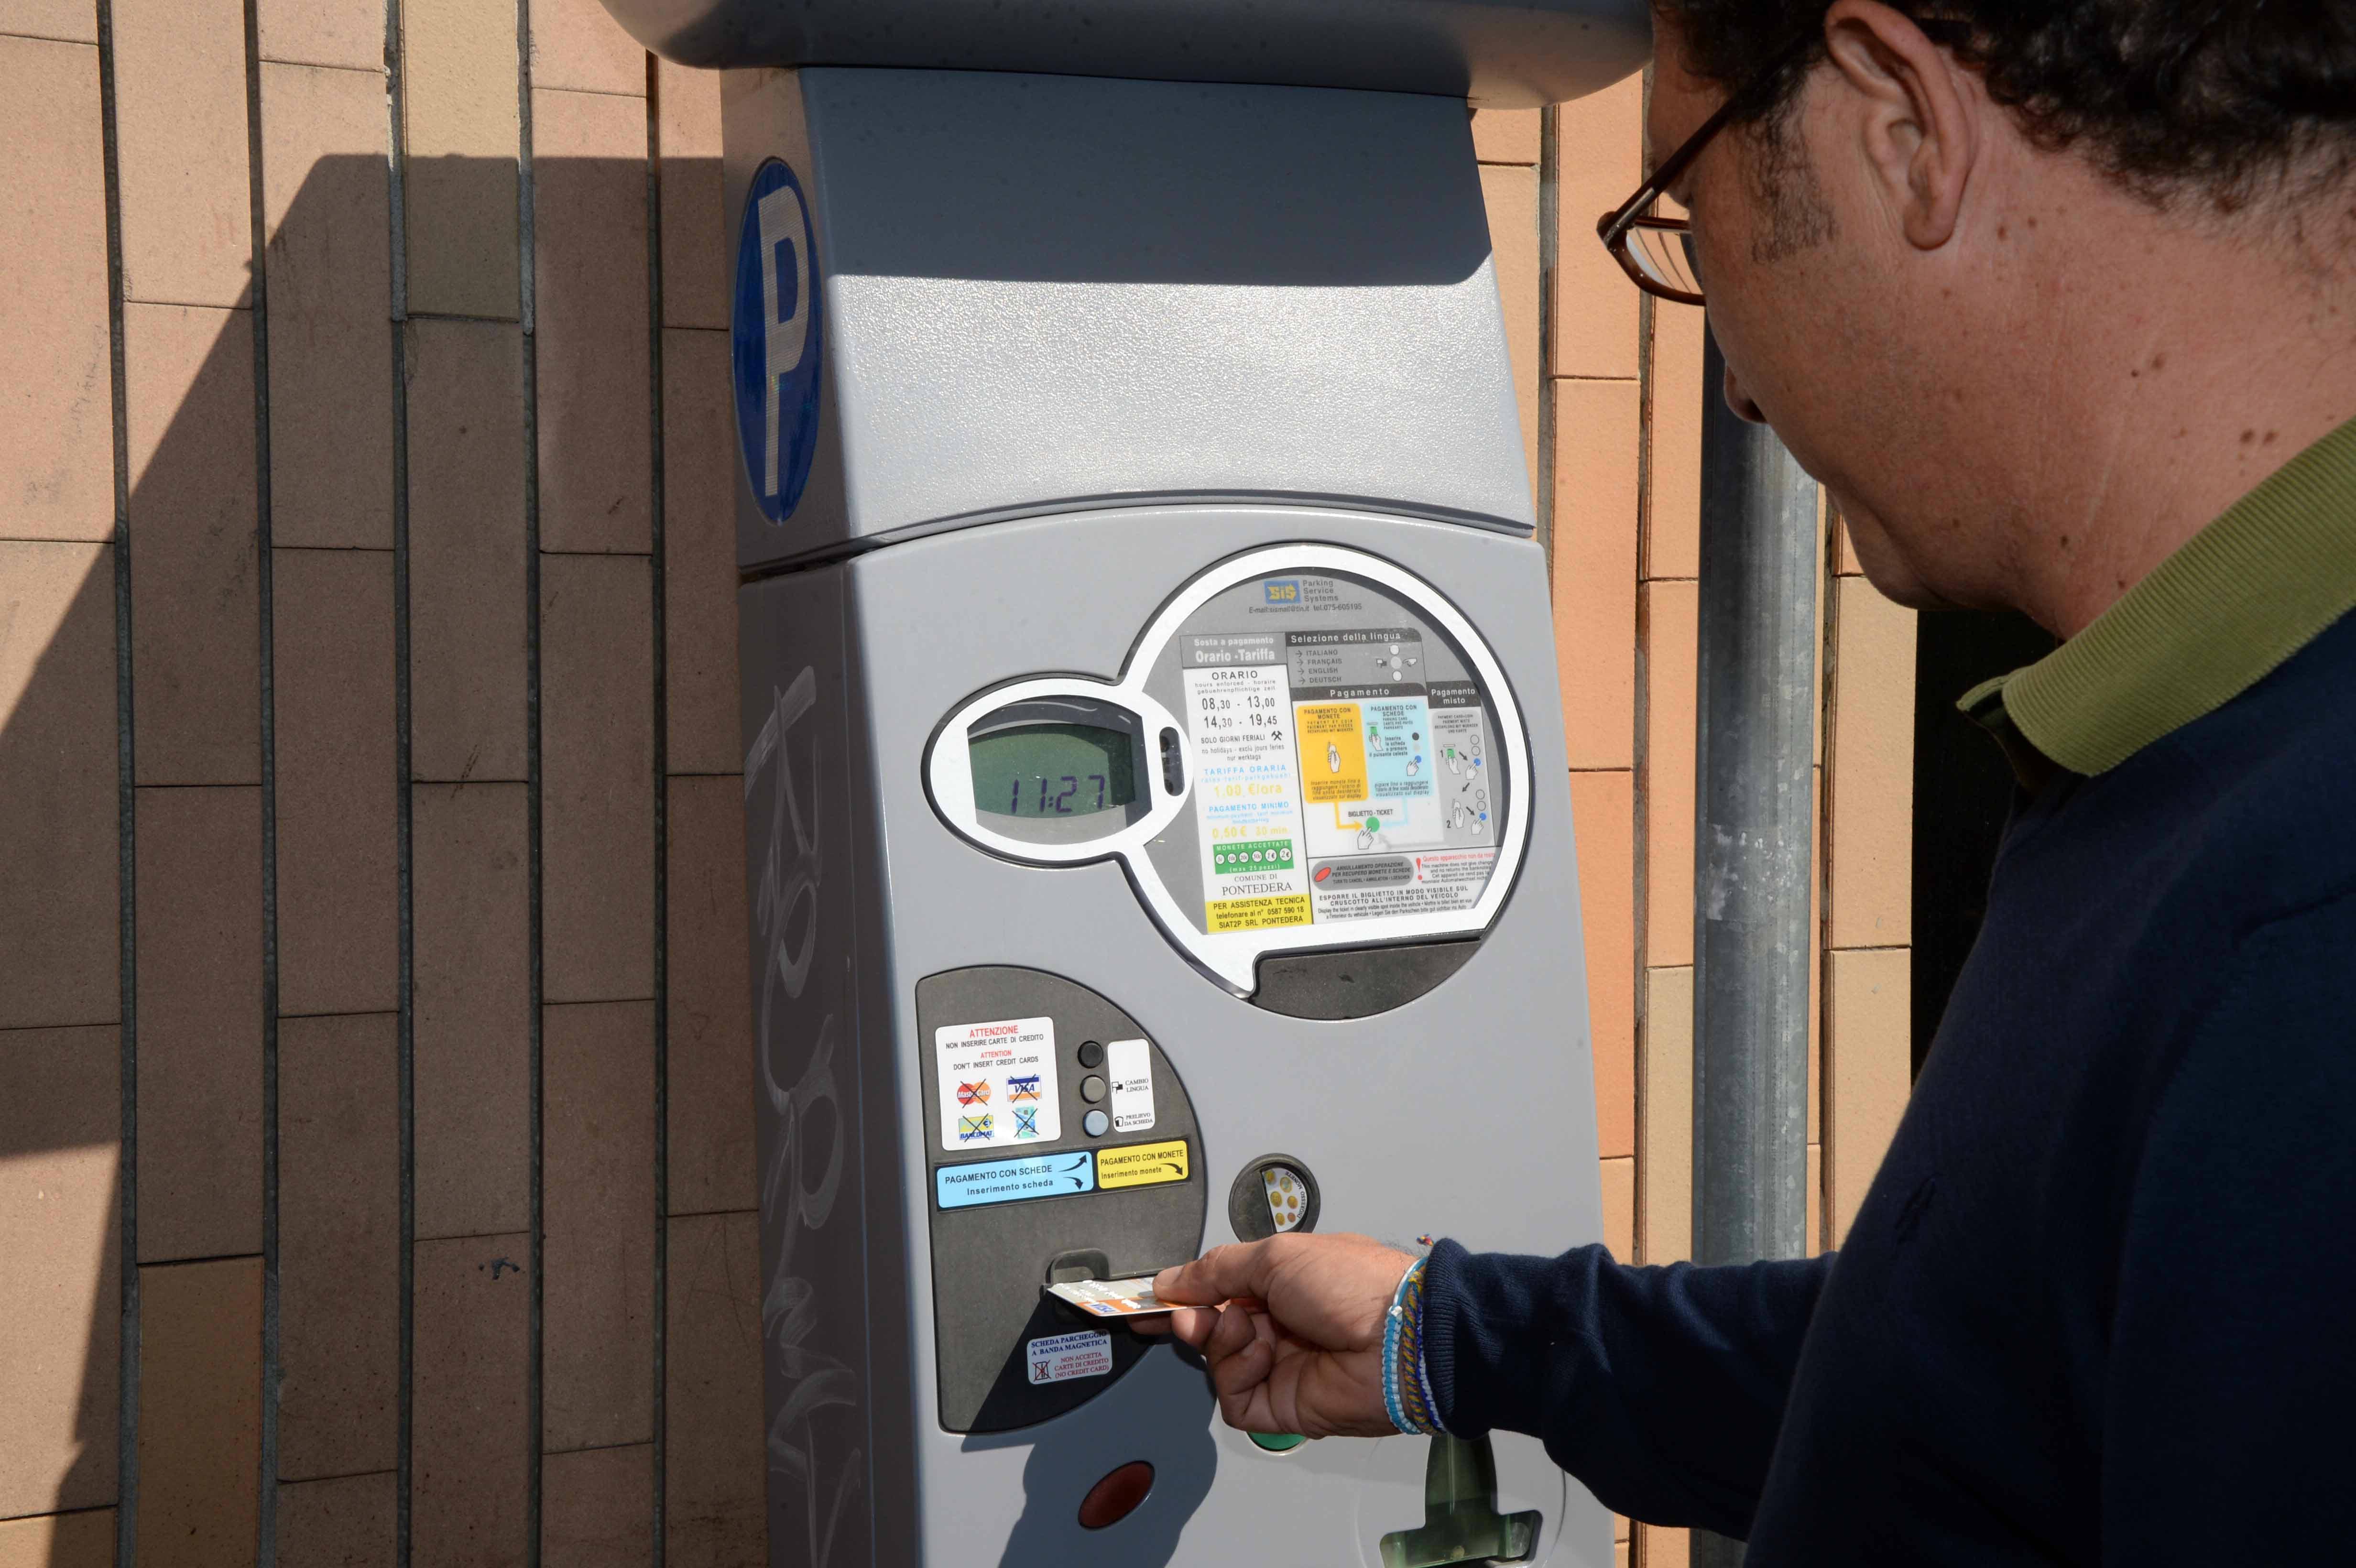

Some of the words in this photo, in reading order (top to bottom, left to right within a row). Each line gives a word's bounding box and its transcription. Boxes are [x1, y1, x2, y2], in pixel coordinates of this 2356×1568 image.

[758, 185, 809, 496] P
[1303, 580, 1333, 588] Parking
[1194, 638, 1218, 646] Sosta
[1228, 637, 1274, 646] pagamento
[1291, 635, 1339, 643] Selezione
[1343, 633, 1366, 641] della
[1371, 632, 1400, 641] lingua
[1196, 650, 1231, 663] Orario
[1212, 671, 1258, 680] ORARIO
[1330, 688, 1389, 698] Pagamento
[1431, 688, 1475, 697] Pagamento
[1202, 697, 1230, 711] 08,30
[1247, 696, 1275, 710] 13,00
[1204, 716, 1232, 730] 14,30
[1250, 714, 1277, 728] 19,45
[1211, 746, 1232, 755] holidays
[1254, 744, 1267, 752] jours
[1238, 752, 1261, 761] werktags
[1205, 767, 1244, 775] TARIFFA
[1250, 764, 1286, 773] ORARIA
[1011, 775, 1104, 813] 11:27
[1209, 804, 1257, 813] PAGAMENTO
[1222, 882, 1292, 896] PONTEDERA
[1231, 899, 1272, 908] ASSISTENZA
[1216, 910, 1248, 919] telefonare
[1219, 921, 1242, 929] SIAT2P
[1262, 916, 1303, 925] PONTEDERA
[970, 1025, 1019, 1038] ATTENZIONE
[961, 1039, 987, 1047] INSERIRE
[1019, 1034, 1044, 1042] CREDITO
[981, 1050, 1012, 1058] ATTENTION
[1101, 1155, 1140, 1166] PAGAMENTO
[1158, 1150, 1183, 1159] MONETE
[945, 1171, 996, 1184] PAGAMENTO
[999, 1170, 1017, 1178] CON
[1019, 1165, 1052, 1176] SCHEDE
[1101, 1170, 1138, 1179] Inserimento
[1140, 1166, 1162, 1177] monete
[967, 1183, 1020, 1196] Inserimento
[1022, 1179, 1053, 1189] scheda
[1031, 1339, 1059, 1348] SCHEDA
[1061, 1331, 1106, 1343] PARCHEGGIO
[1040, 1347, 1064, 1355] BANDA
[1065, 1339, 1107, 1350] MAGNETICA
[1076, 1352, 1102, 1361] ACCETTA
[1083, 1358, 1109, 1366] CREDITO
